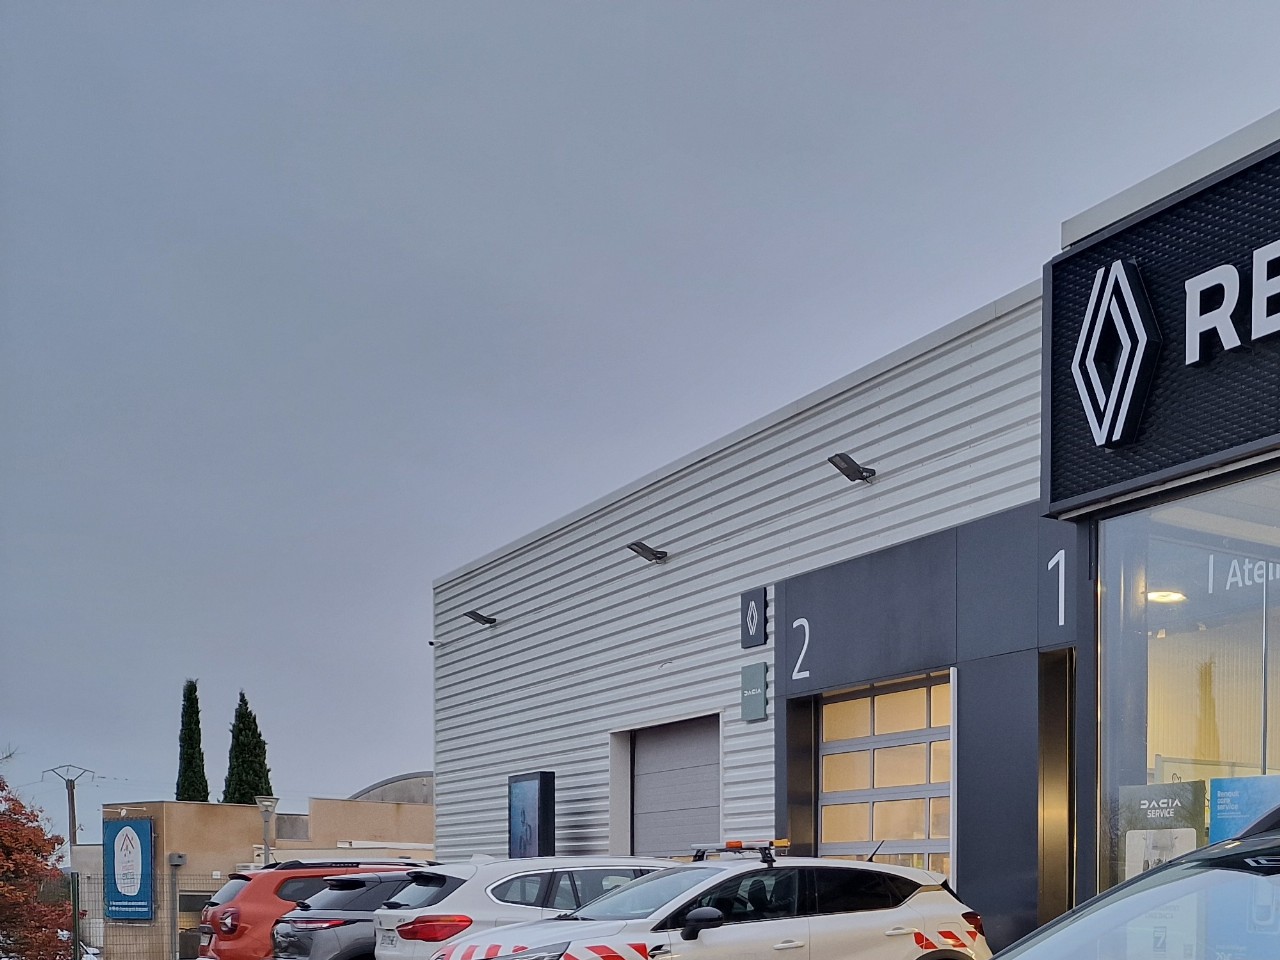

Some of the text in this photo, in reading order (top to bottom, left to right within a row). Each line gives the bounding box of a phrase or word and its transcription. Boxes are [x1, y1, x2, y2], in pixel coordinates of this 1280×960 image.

[1047, 549, 1065, 626] 1
[792, 617, 810, 680] 2
[743, 688, 762, 696] DACIA
[1140, 798, 1182, 809] DACIA
[1146, 808, 1175, 818] SERVICE
